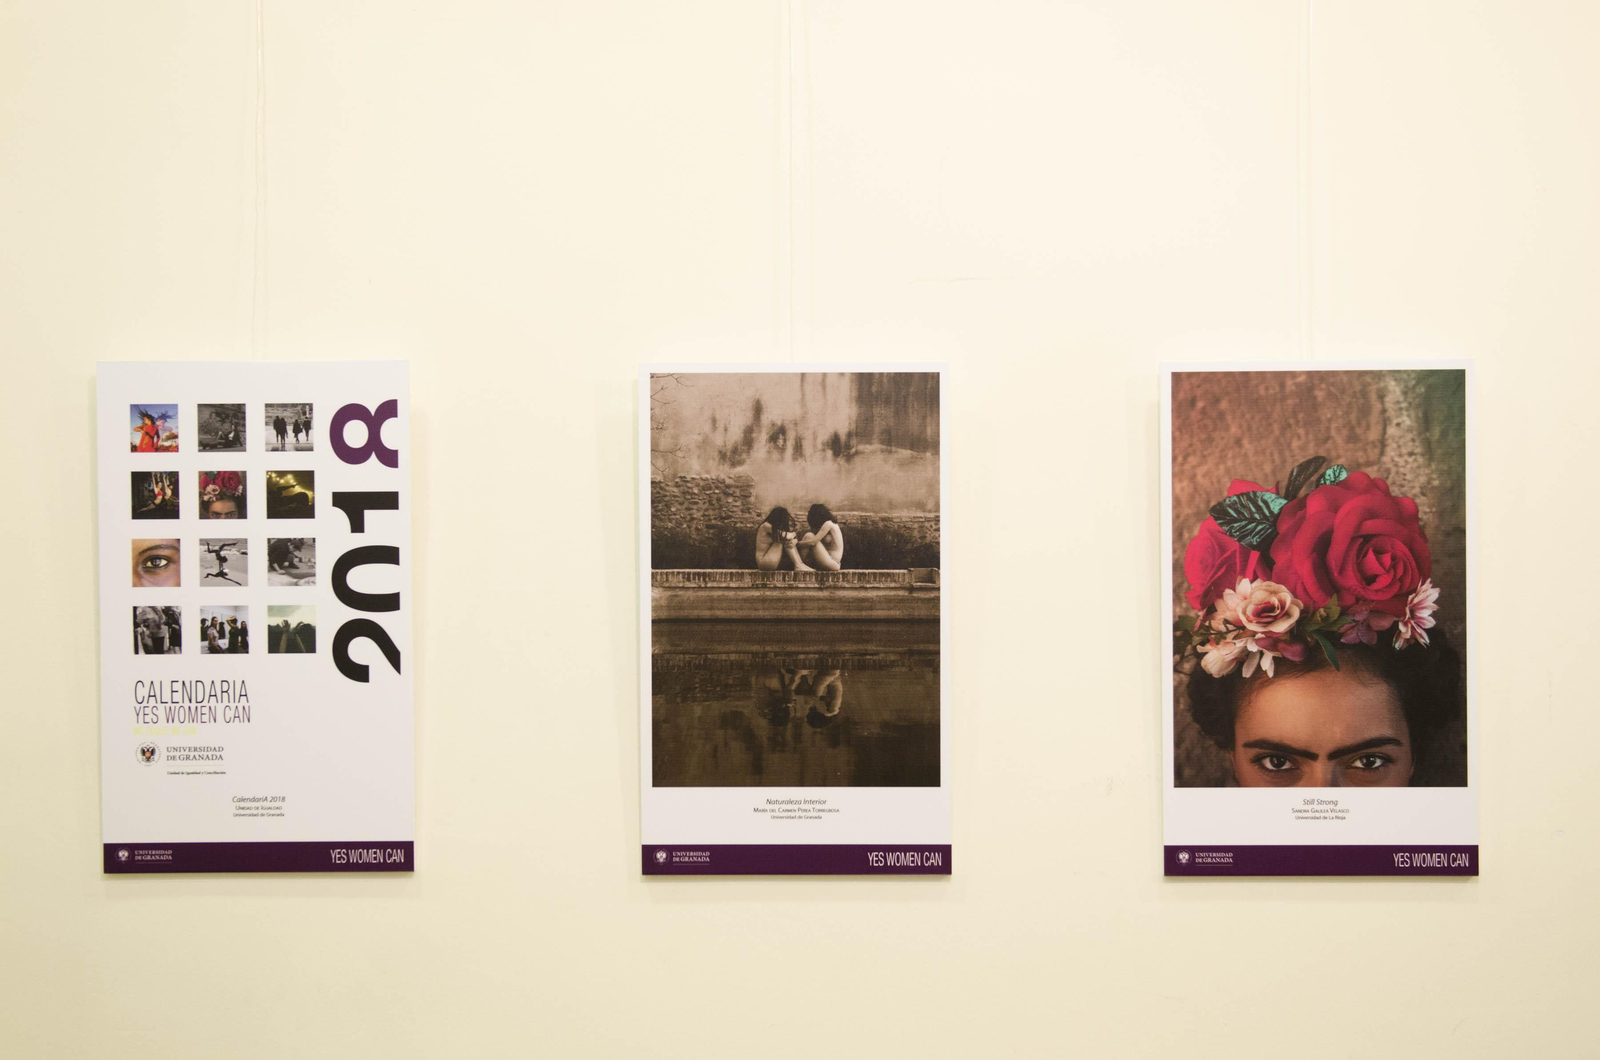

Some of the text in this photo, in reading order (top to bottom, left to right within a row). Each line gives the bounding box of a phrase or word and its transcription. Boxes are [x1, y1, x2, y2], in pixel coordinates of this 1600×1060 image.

[329, 399, 401, 683] 2018
[134, 680, 249, 704] CALENDARIA
[134, 705, 250, 724] YES WOMEN CAN
[1316, 799, 1338, 807] Strong
[330, 849, 404, 864] YES WOMEN CAN
[868, 852, 942, 866] YES WOMEN CAN
[1393, 853, 1469, 867] YES WOMEN CAN
